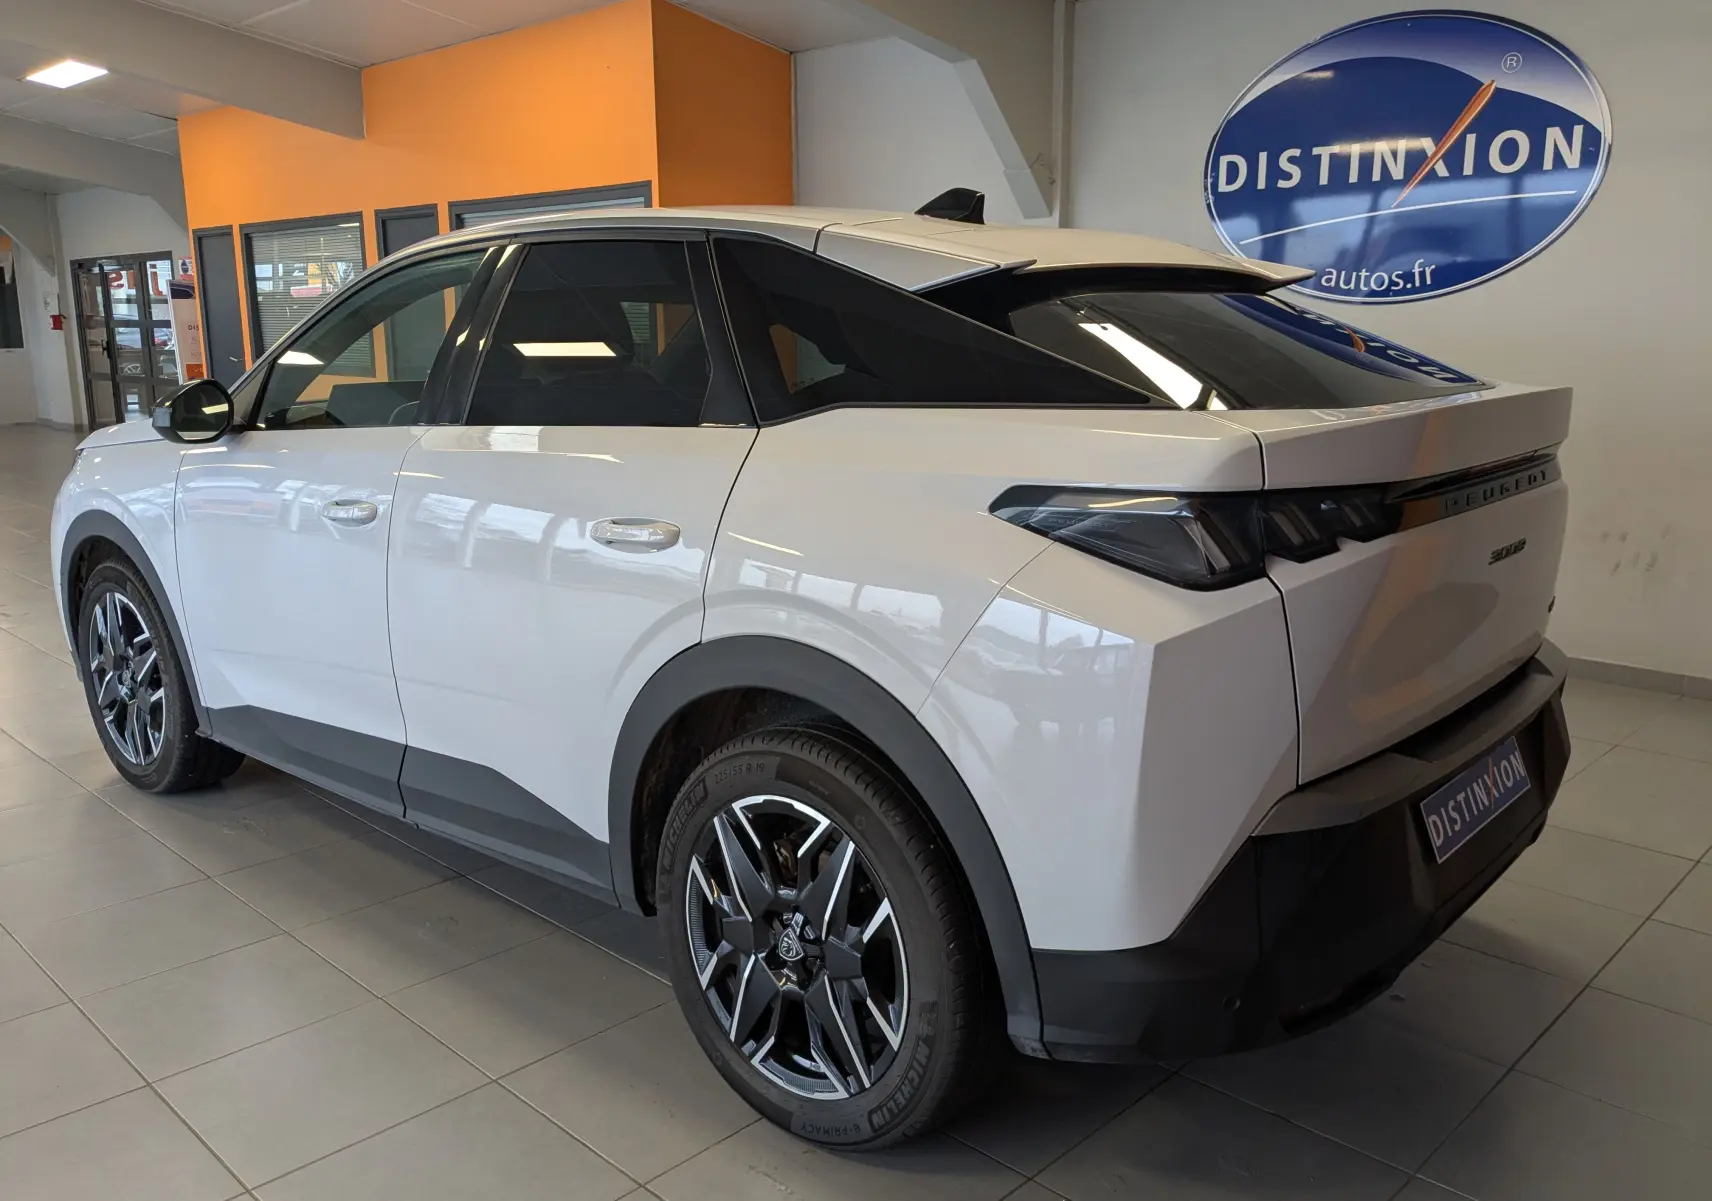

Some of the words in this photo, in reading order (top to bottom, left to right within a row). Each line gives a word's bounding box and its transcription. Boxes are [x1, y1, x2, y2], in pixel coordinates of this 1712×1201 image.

[1217, 123, 1585, 195] DISTINXION
[1320, 259, 1437, 292] autos.fr
[1445, 470, 1547, 513] PEUGEOT
[755, 761, 766, 773] 19
[1427, 751, 1526, 847] DISTINXION
[870, 1039, 932, 1131] MICHELIN
[800, 1121, 862, 1137] e-PRIMACY
